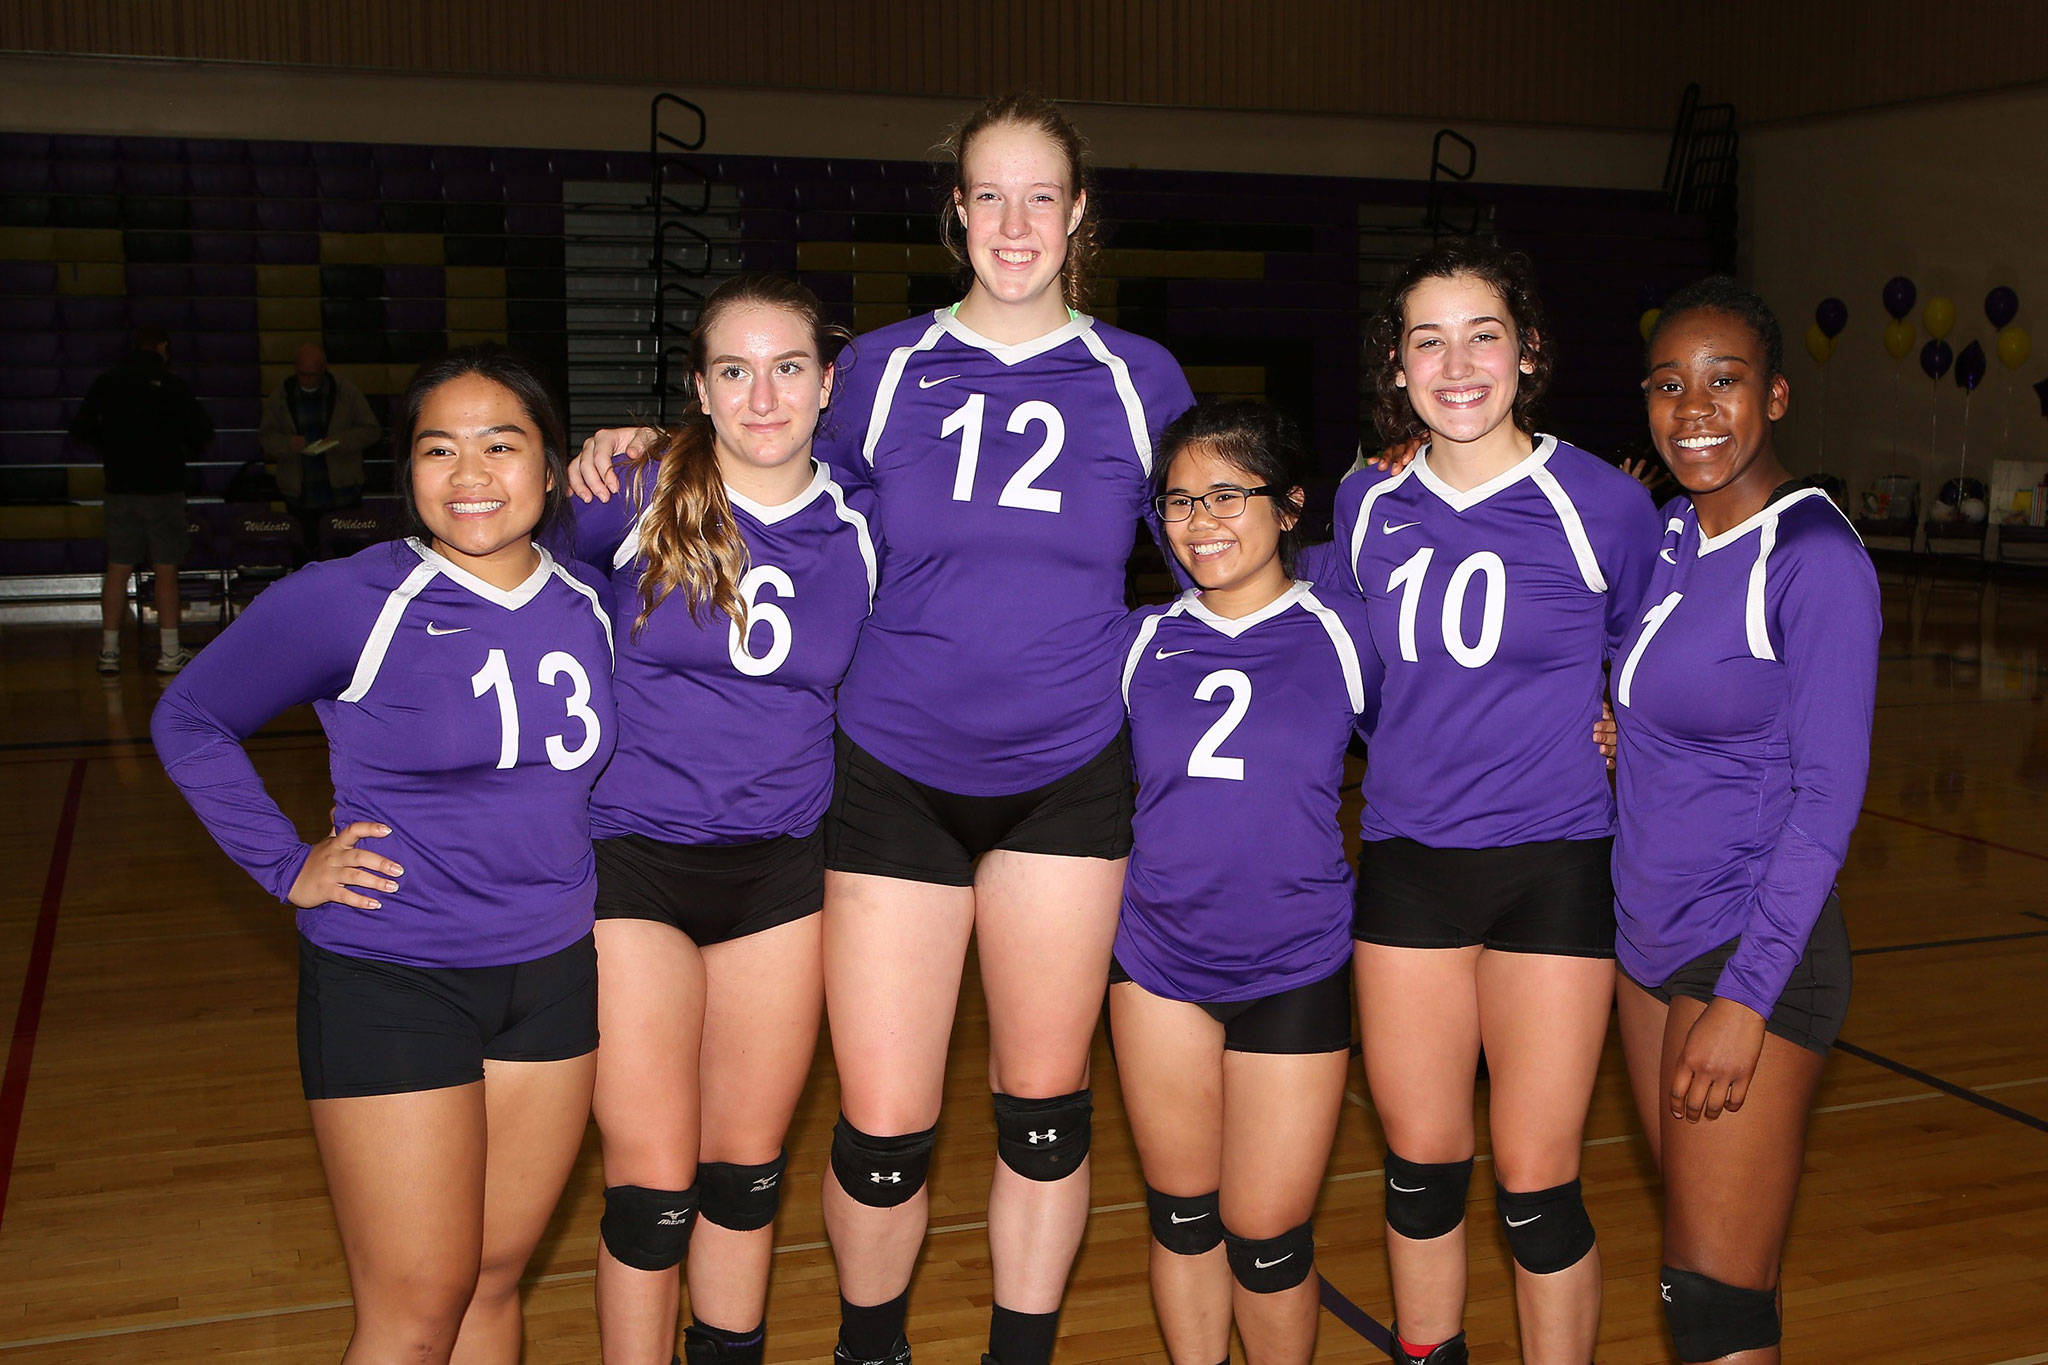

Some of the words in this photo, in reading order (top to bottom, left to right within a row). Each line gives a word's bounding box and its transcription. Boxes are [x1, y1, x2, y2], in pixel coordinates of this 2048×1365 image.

[941, 394, 1066, 514] 12
[729, 565, 796, 677] 6
[1387, 548, 1506, 669] 10
[472, 649, 601, 771] 13
[1188, 670, 1252, 781] 2
